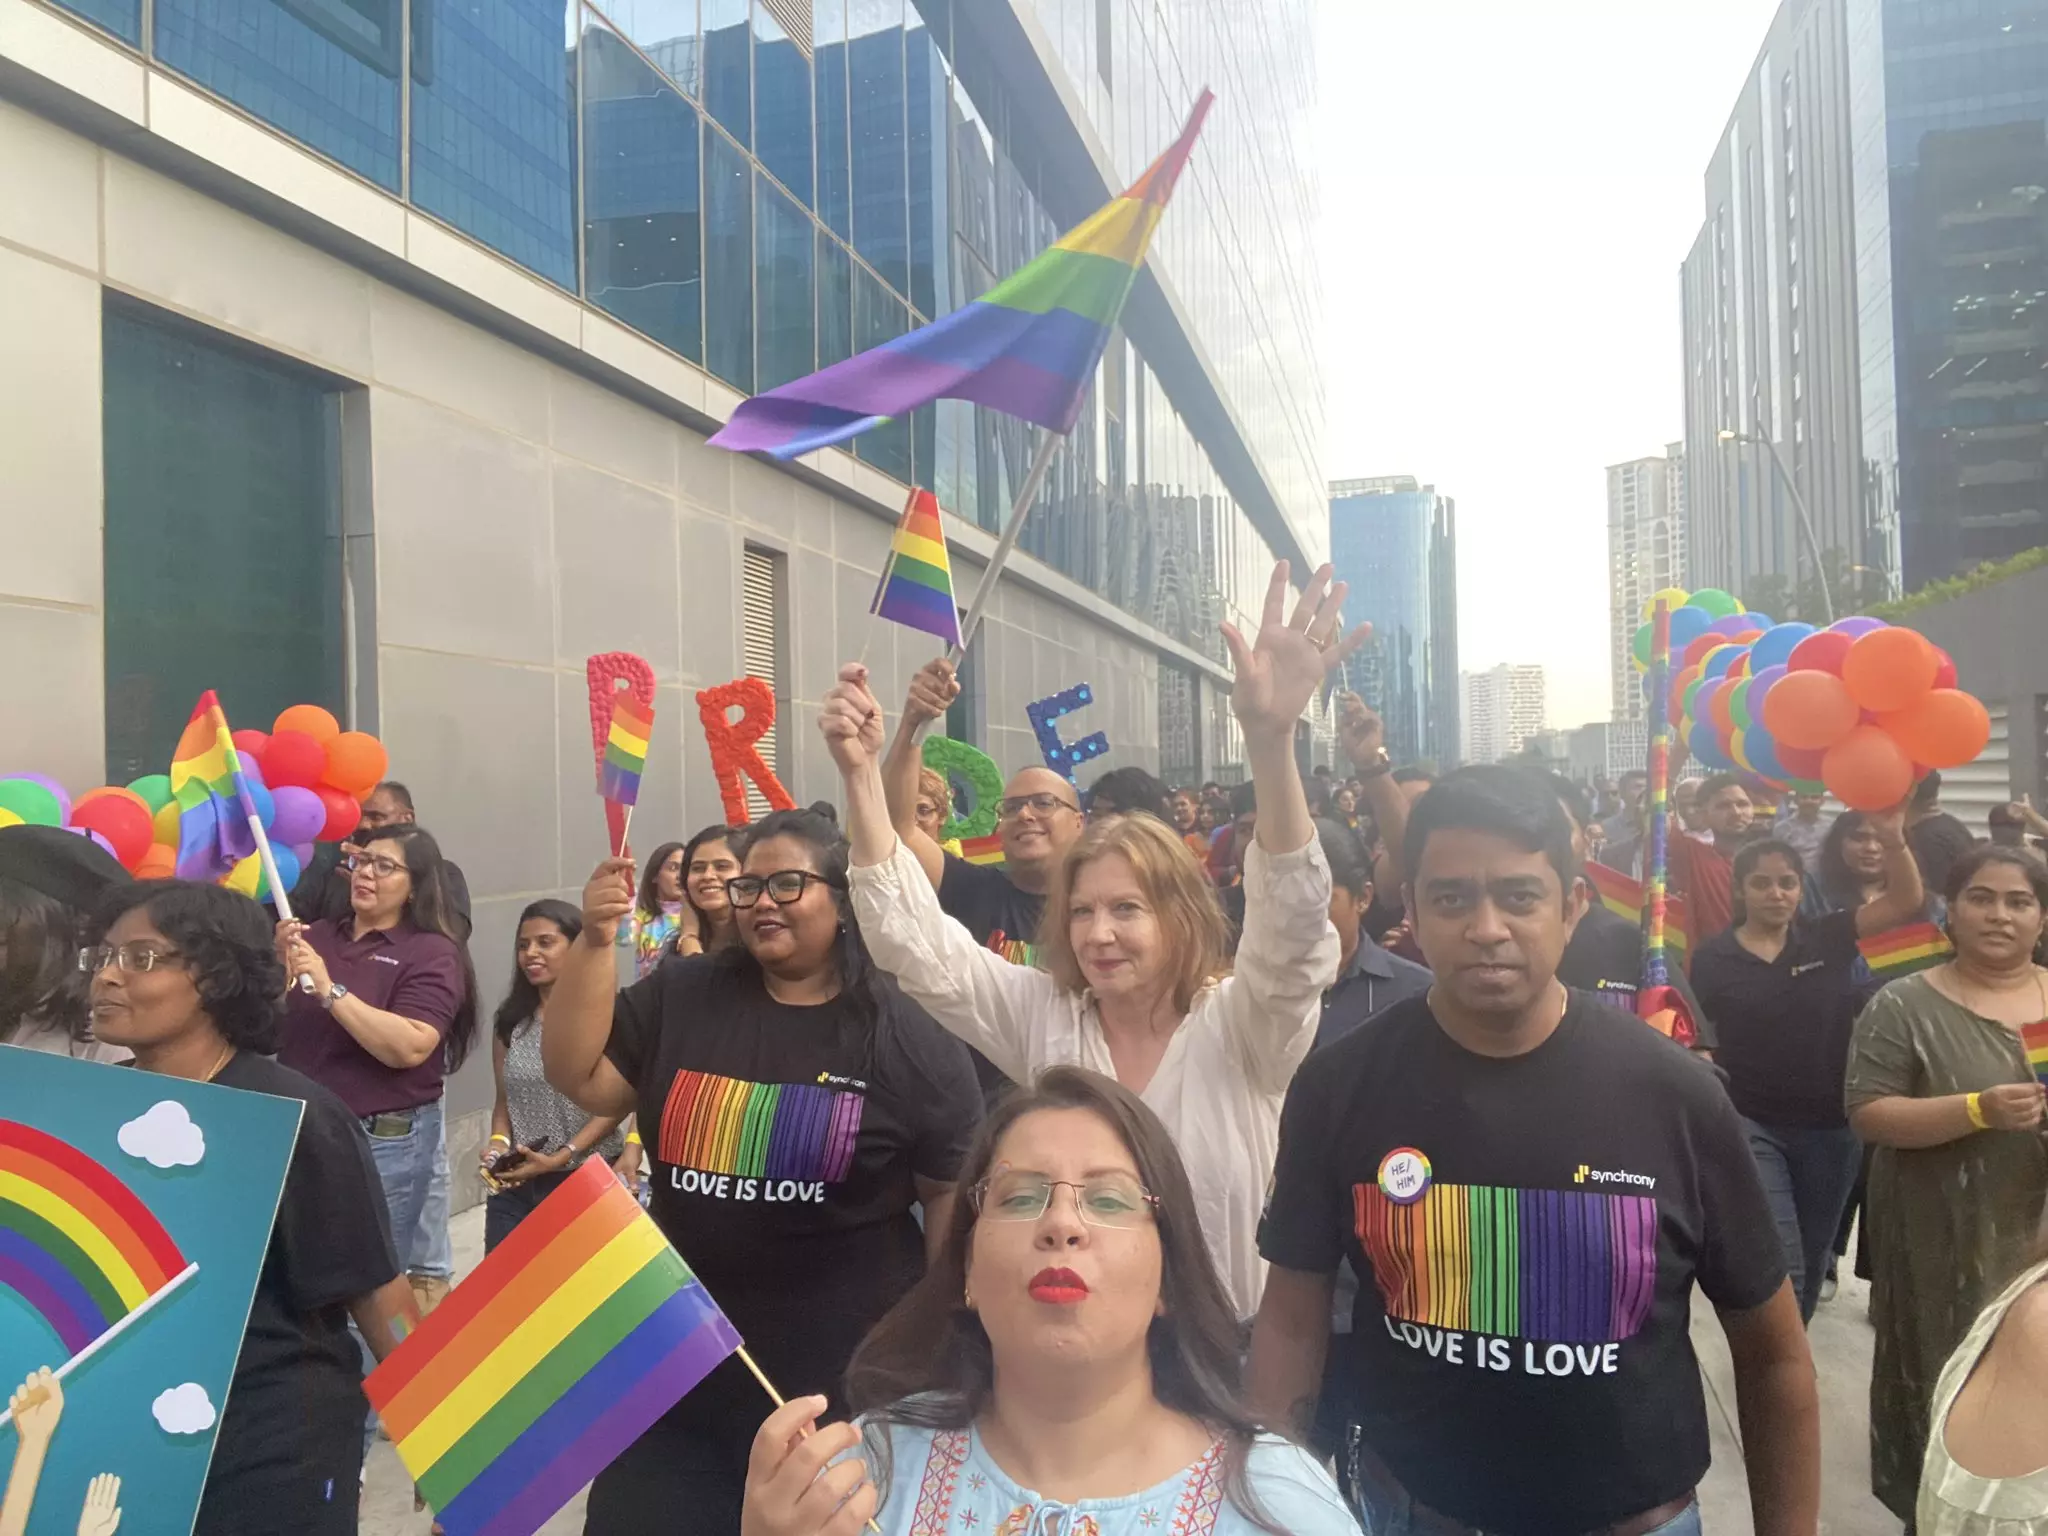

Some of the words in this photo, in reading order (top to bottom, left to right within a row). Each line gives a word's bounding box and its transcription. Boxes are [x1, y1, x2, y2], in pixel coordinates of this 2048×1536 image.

[695, 676, 798, 827] R
[1391, 1158, 1412, 1176] HE/
[1591, 1169, 1656, 1189] synchrony
[671, 1166, 730, 1199] LOVE
[734, 1178, 758, 1201] IS
[764, 1179, 825, 1203] LOVE
[1396, 1174, 1416, 1190] HIM
[1384, 1314, 1464, 1365] LOVE
[1477, 1336, 1511, 1372] IS
[1524, 1342, 1620, 1376] LOVE
